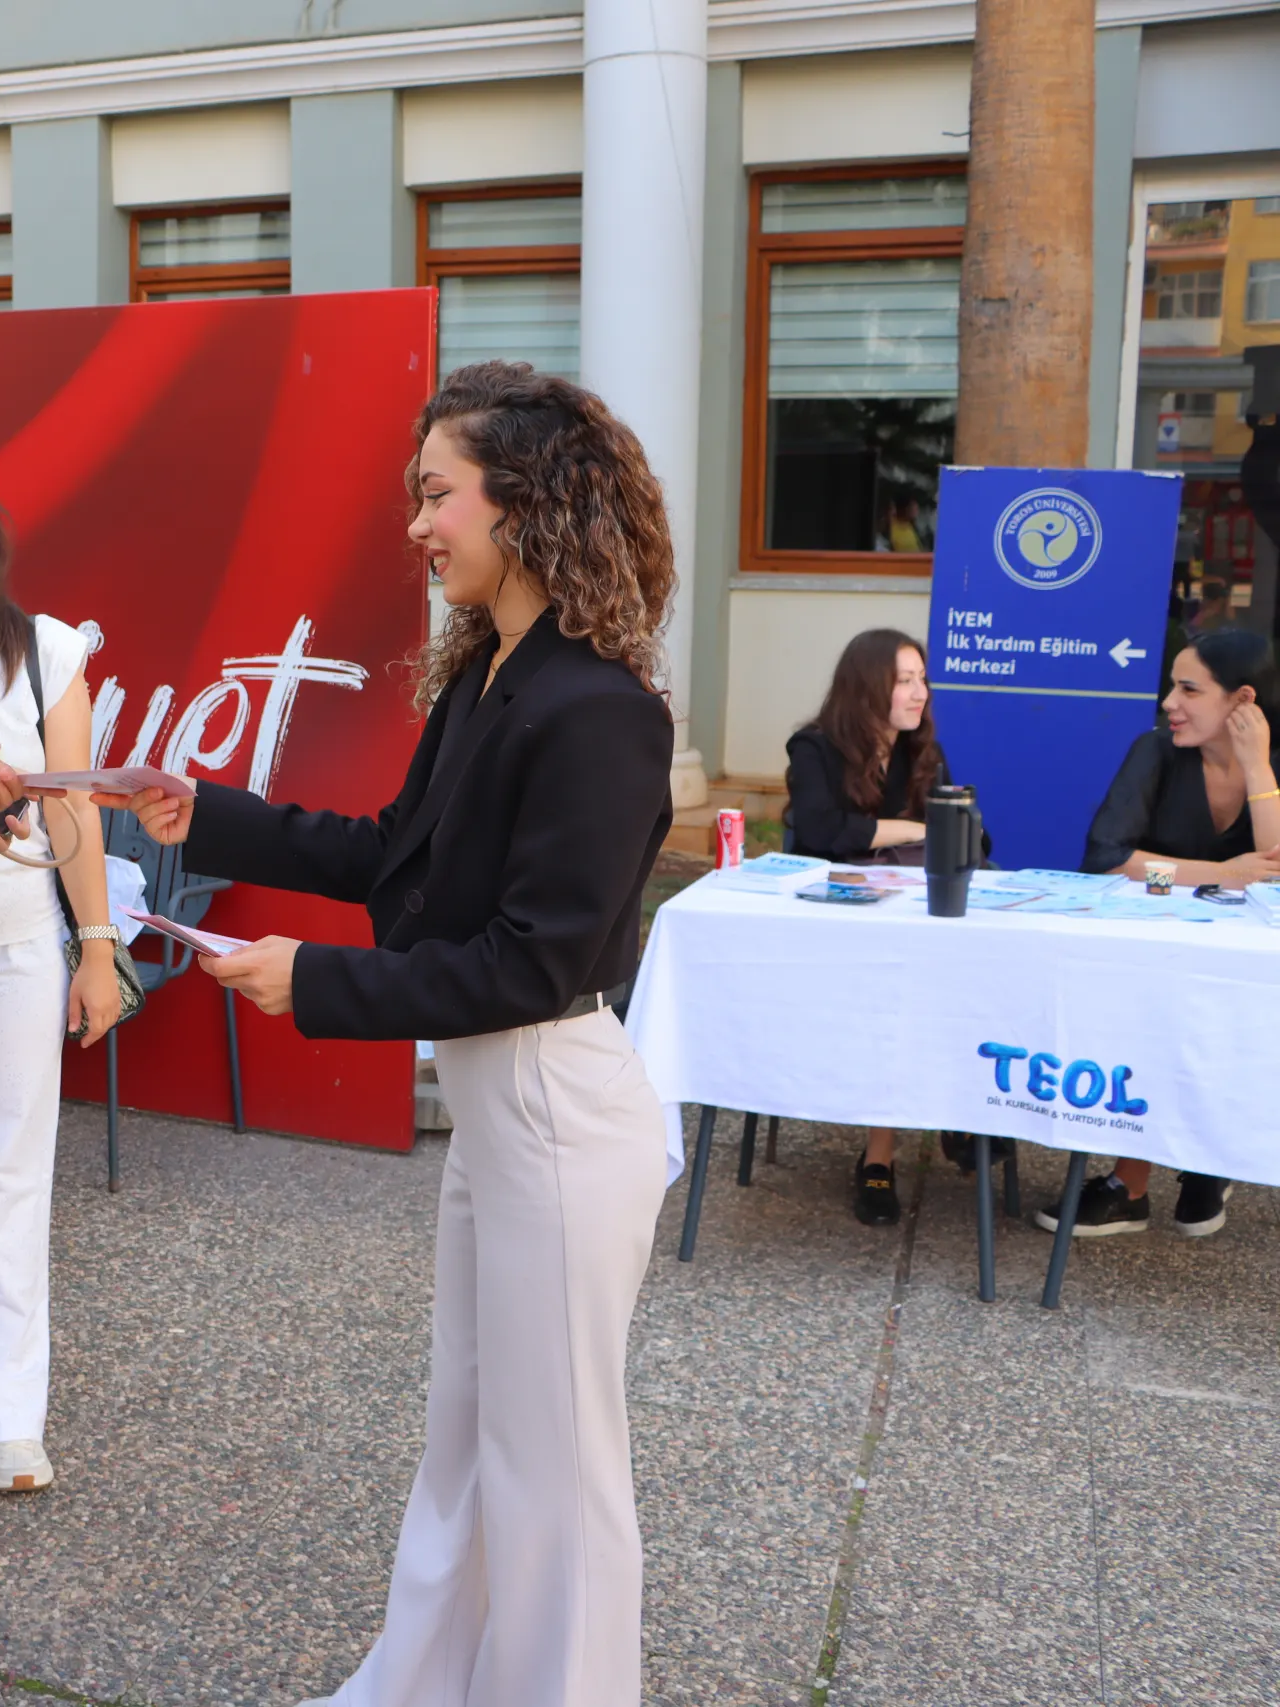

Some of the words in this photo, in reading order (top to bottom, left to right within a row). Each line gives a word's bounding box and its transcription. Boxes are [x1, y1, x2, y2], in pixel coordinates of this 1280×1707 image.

[1004, 503, 1035, 535] TOROS
[1033, 568, 1058, 579] 2009
[947, 607, 993, 628] İYEM
[946, 630, 970, 649] İlk
[974, 633, 1036, 653] Yardım
[1039, 637, 1098, 657] Eğitim
[944, 656, 1016, 675] Merkezi
[977, 1040, 1149, 1116] TEOL
[1005, 1099, 1050, 1117] KURSLARI
[1051, 1110, 1058, 1119] &
[1061, 1112, 1107, 1128] YURTDIŞI
[1109, 1118, 1145, 1134] EĞİTİM
